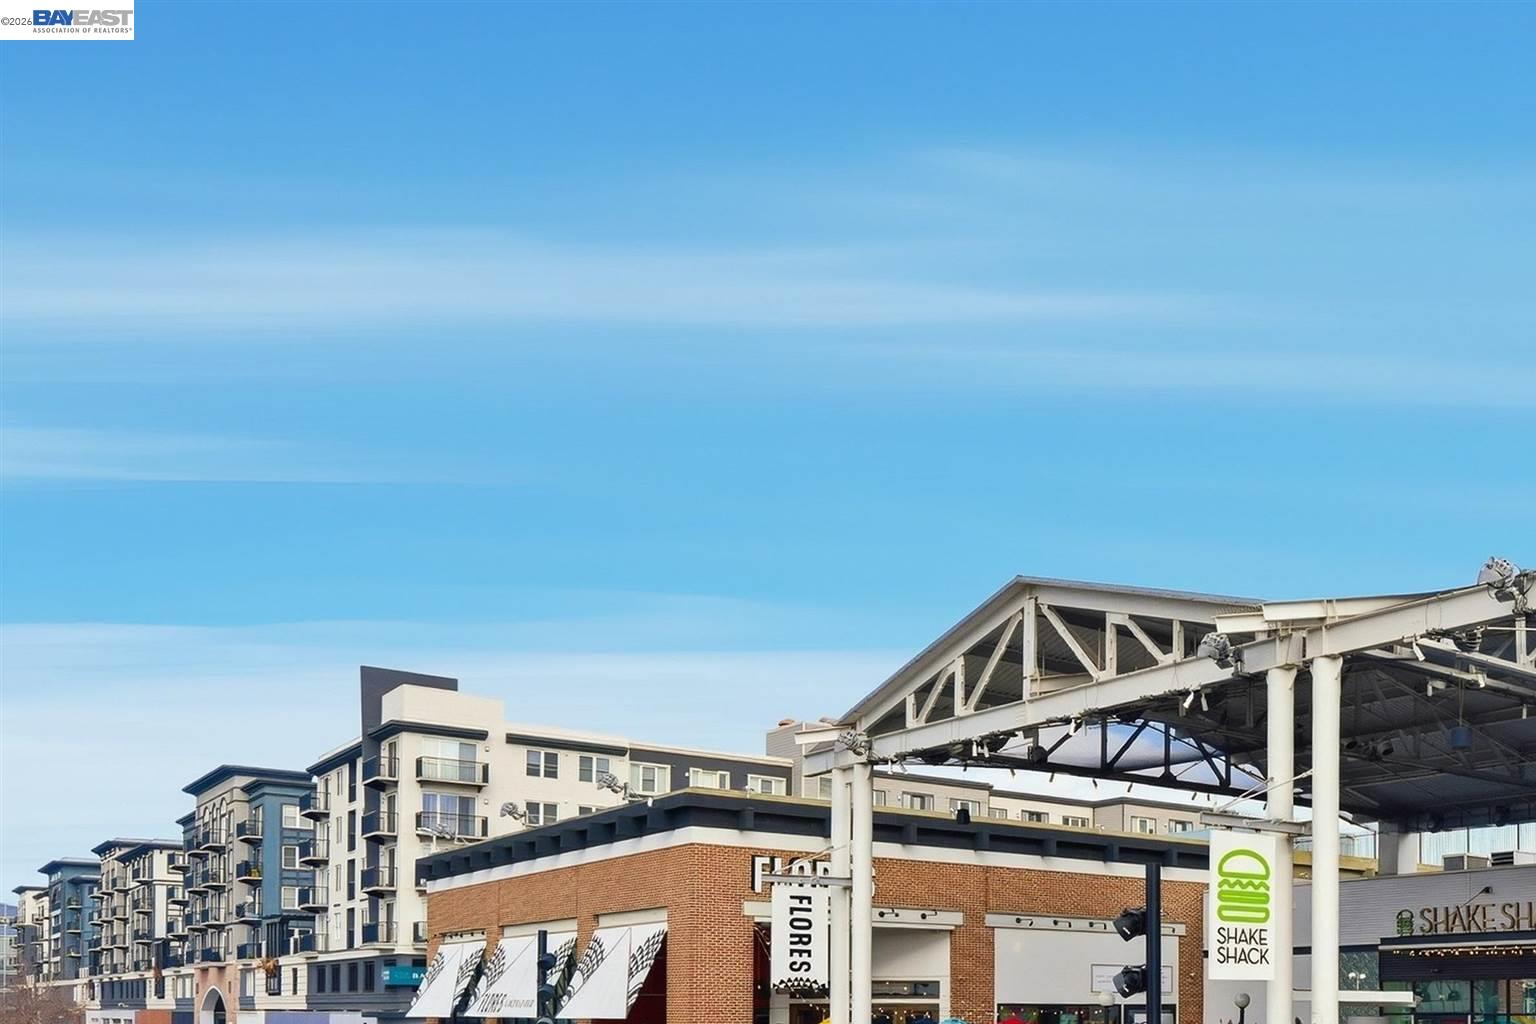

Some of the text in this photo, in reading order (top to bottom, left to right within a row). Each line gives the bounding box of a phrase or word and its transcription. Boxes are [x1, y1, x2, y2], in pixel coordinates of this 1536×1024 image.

[1419, 903, 1497, 936] SHAKE
[788, 895, 813, 973] FLORES
[1217, 926, 1268, 946] SHAKE
[1216, 946, 1270, 965] SHACK
